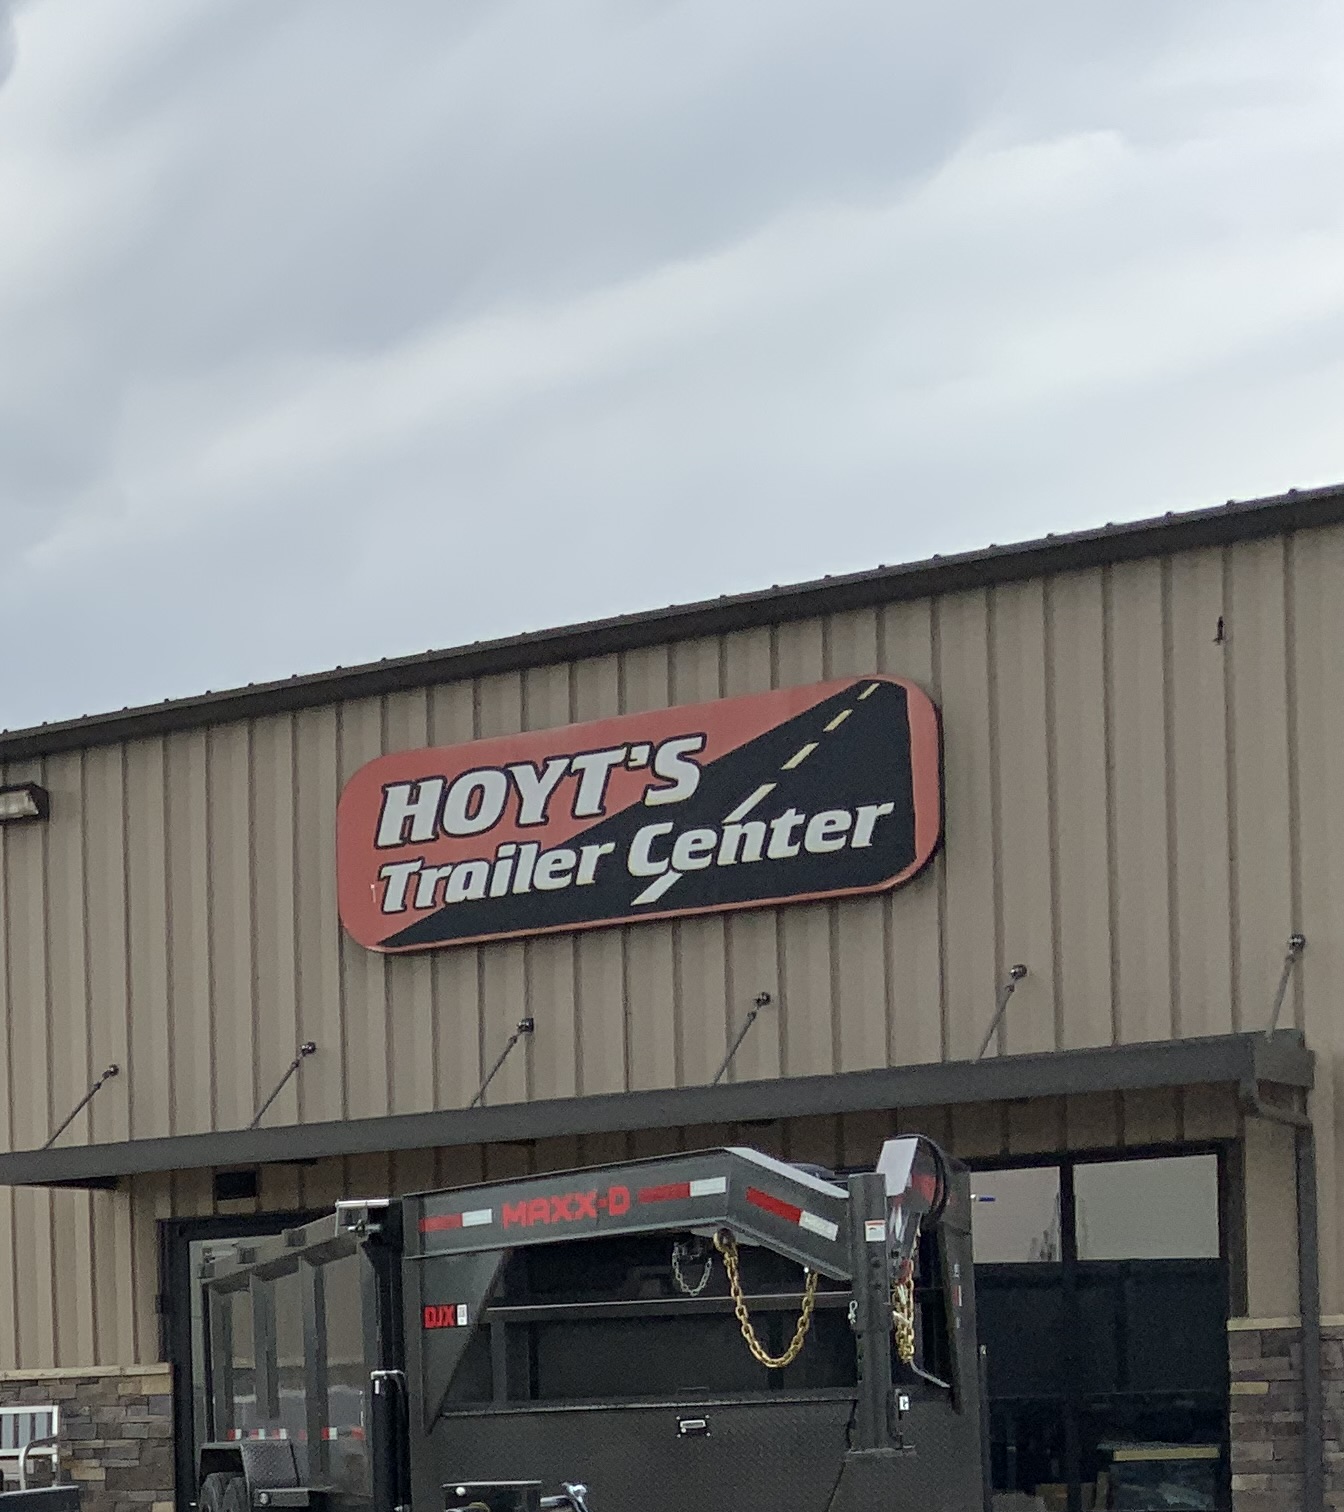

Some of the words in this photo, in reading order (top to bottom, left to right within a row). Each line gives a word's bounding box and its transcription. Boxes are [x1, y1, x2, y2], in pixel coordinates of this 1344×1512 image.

[375, 735, 707, 848] HOYT'S
[378, 841, 615, 913] Trailer
[626, 801, 895, 878] Center
[501, 1184, 631, 1231] MAXX-D
